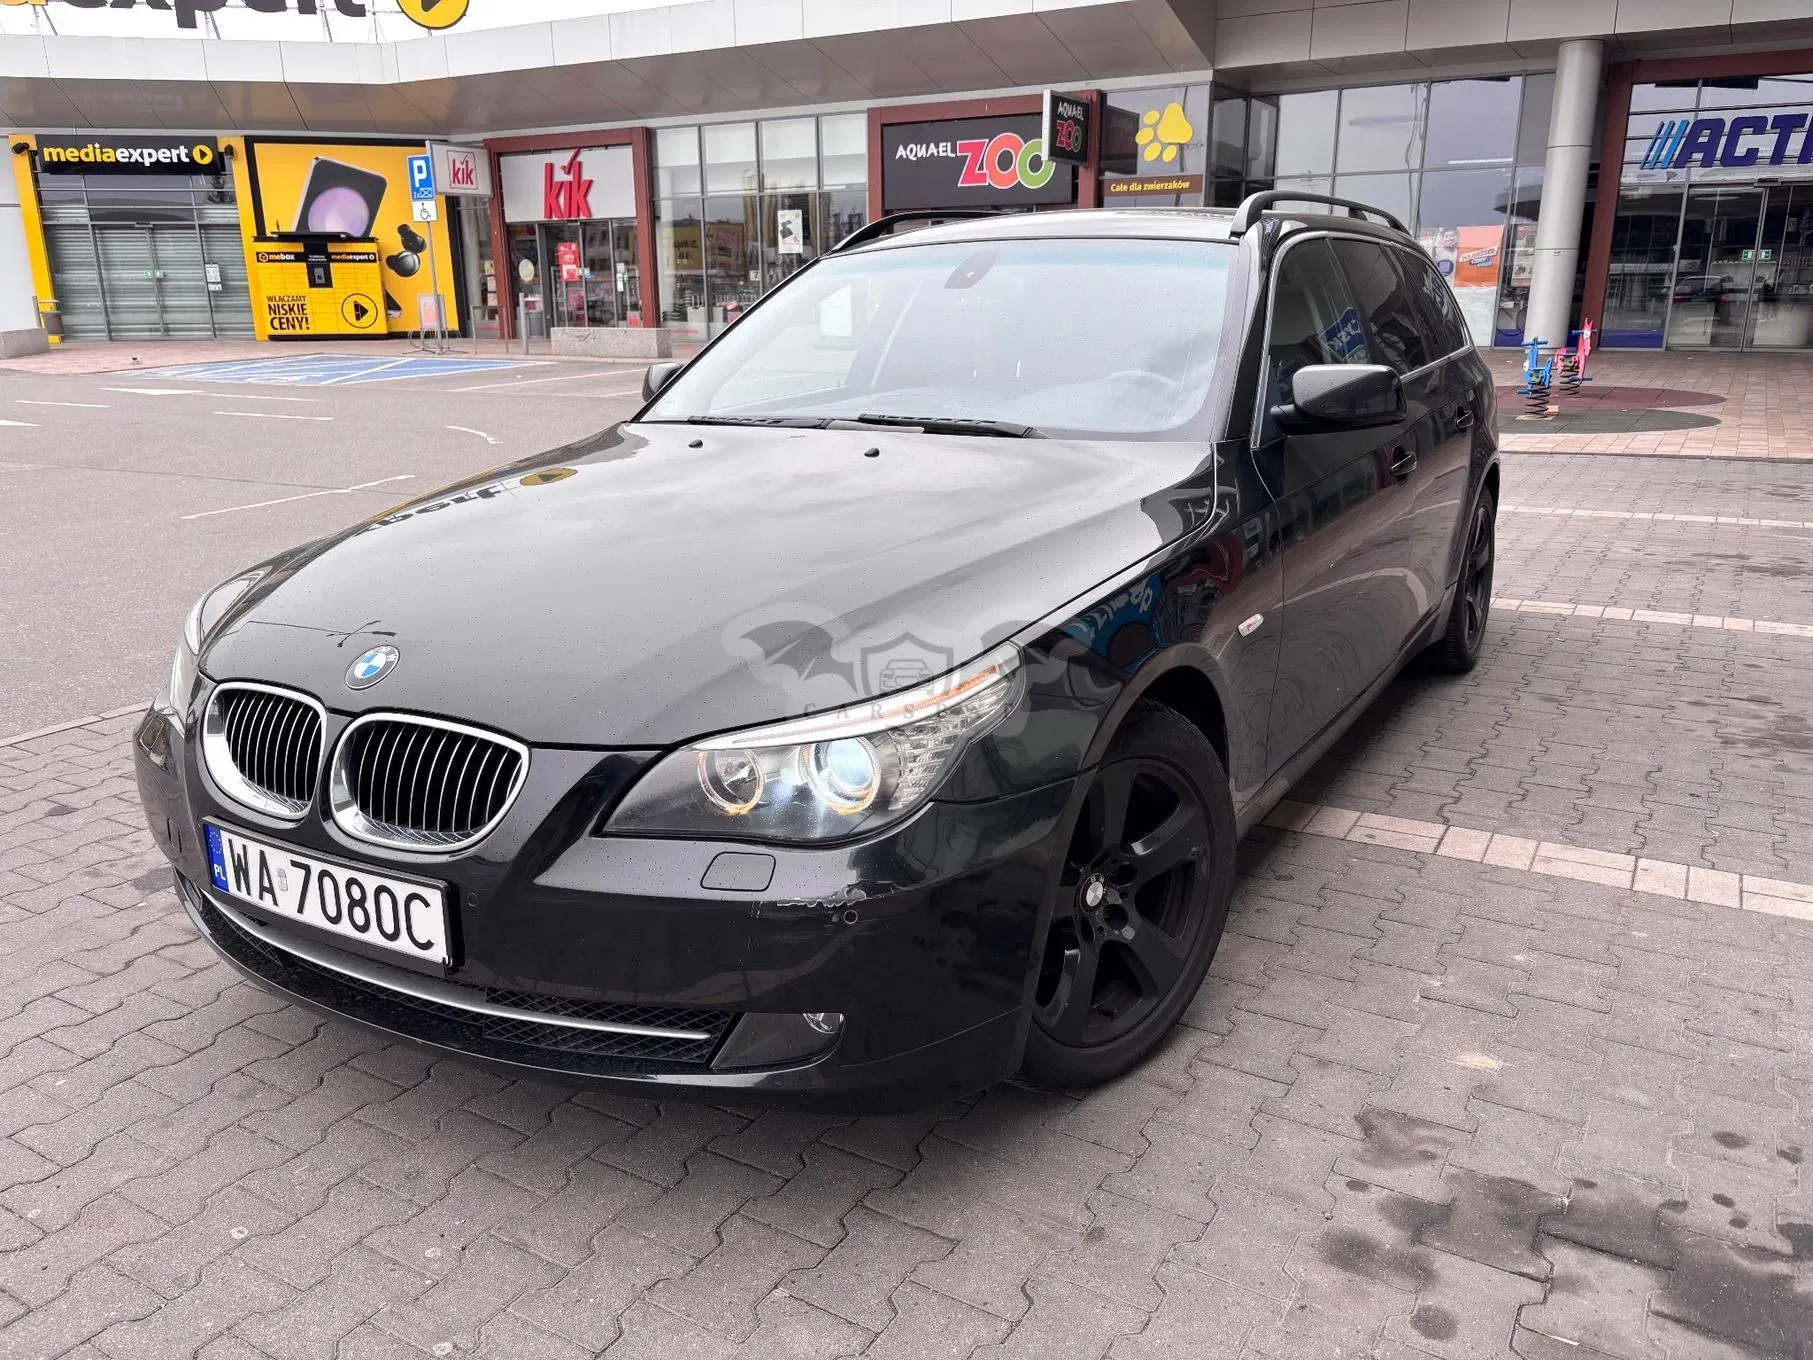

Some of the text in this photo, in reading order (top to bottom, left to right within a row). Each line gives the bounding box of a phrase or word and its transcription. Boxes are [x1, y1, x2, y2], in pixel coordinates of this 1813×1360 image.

[1057, 101, 1084, 121] AQUAEL
[1056, 120, 1082, 153] ZOO
[43, 143, 190, 166] mediaexpert
[895, 132, 1056, 189] AQUAEL ZOO
[412, 160, 427, 187] P
[1129, 182, 1142, 191] dla
[1143, 180, 1190, 191] zwierzaków
[268, 303, 308, 316] NISKIE
[270, 317, 310, 331] CENY!
[213, 863, 227, 881] PL
[228, 838, 434, 951] WA 7080C
